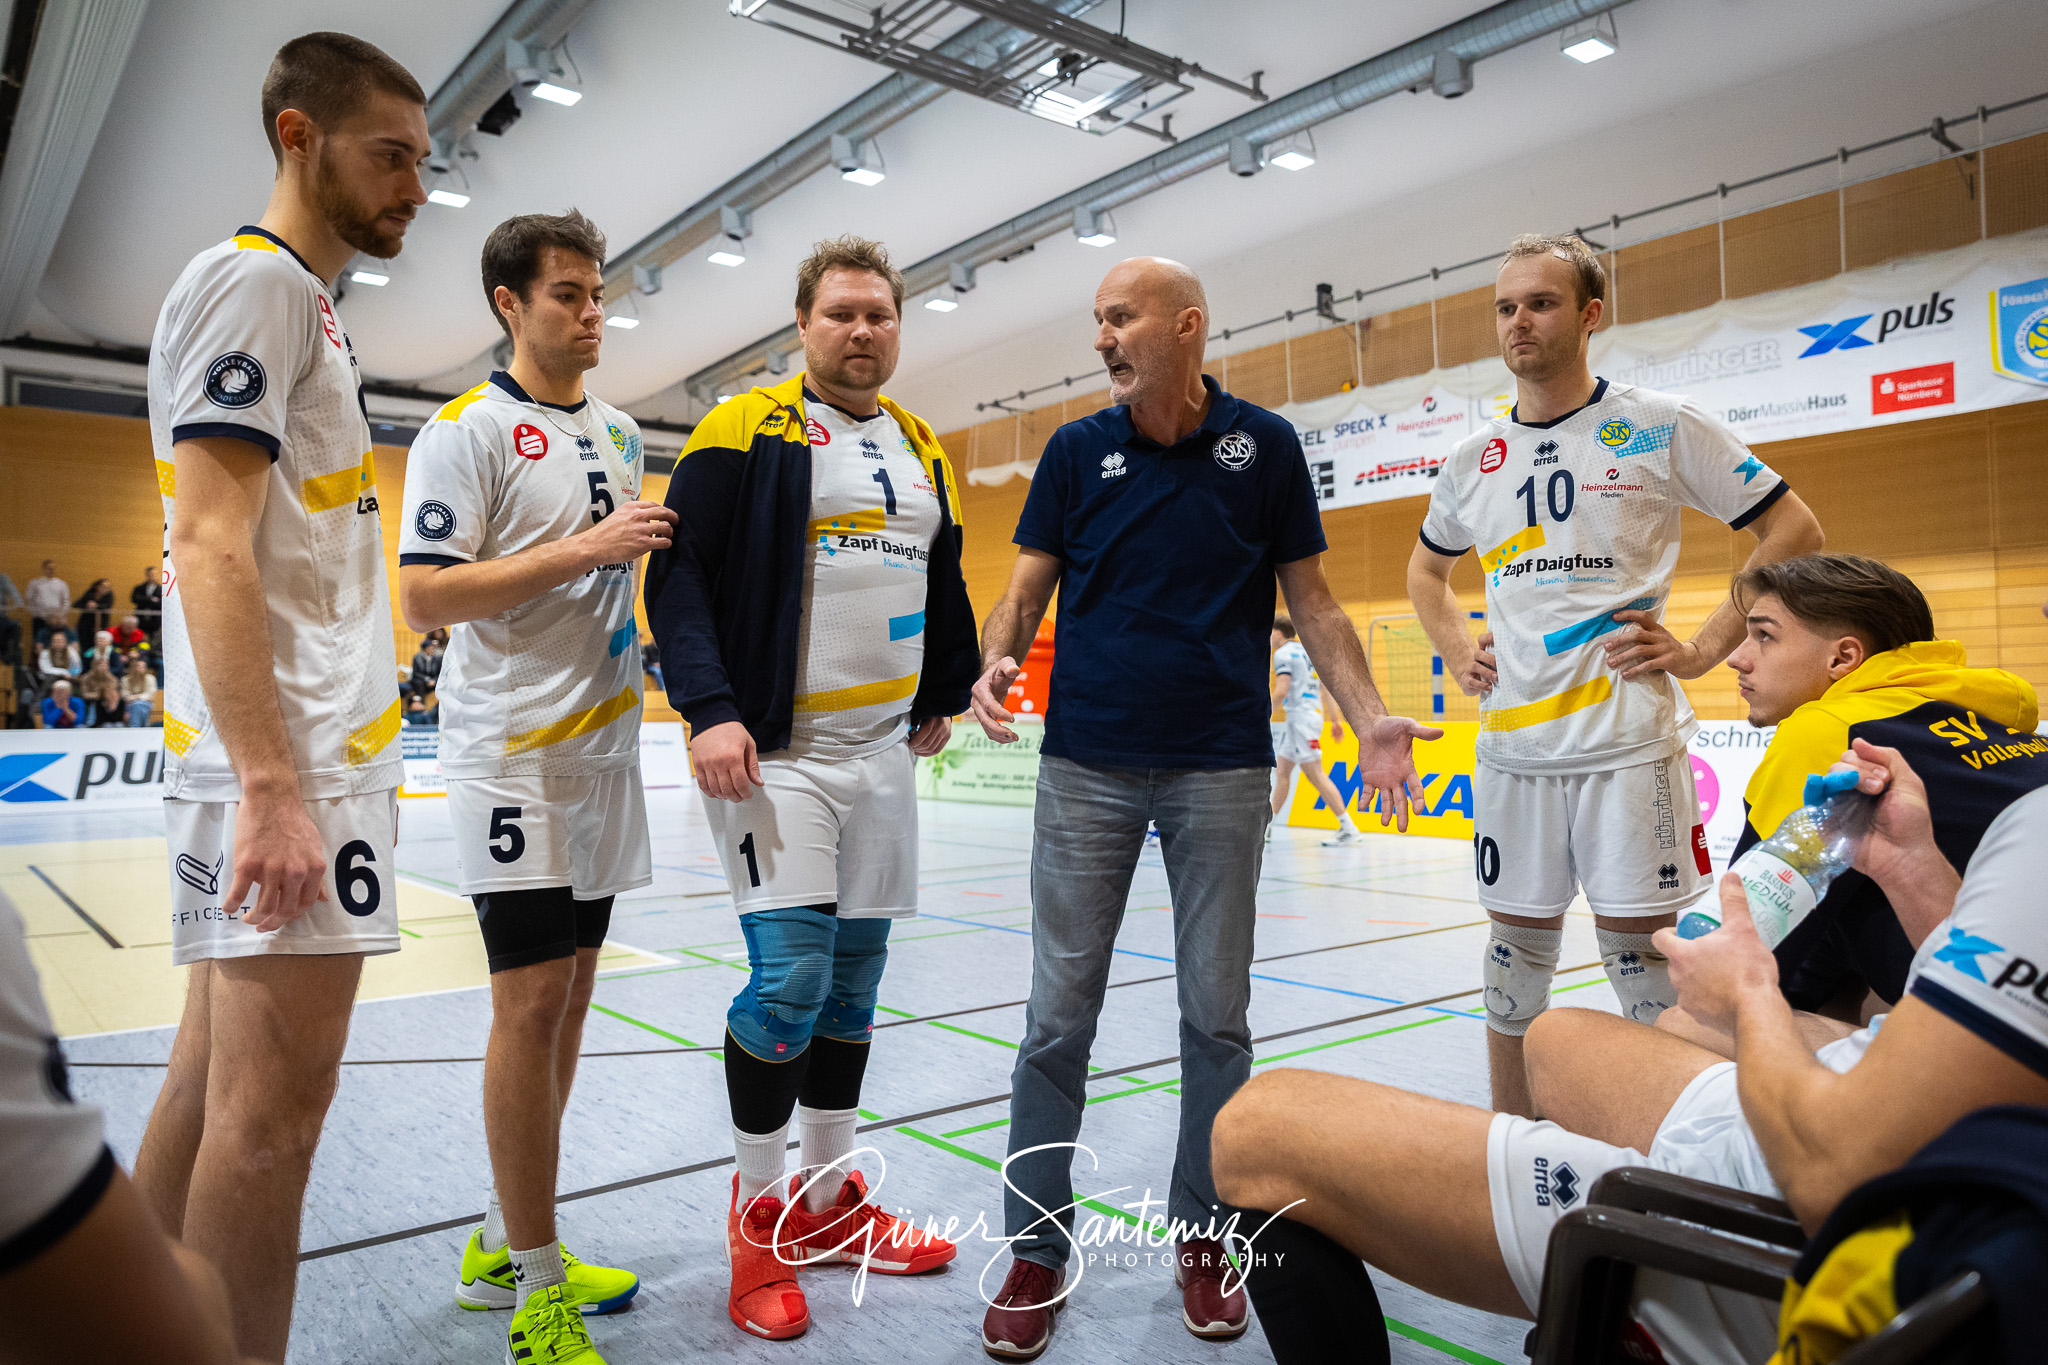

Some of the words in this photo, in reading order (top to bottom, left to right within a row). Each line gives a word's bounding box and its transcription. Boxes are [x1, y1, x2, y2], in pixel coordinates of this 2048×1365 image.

[1877, 291, 1955, 343] puls
[211, 358, 259, 379] VOLLEYBALL
[1896, 375, 1945, 393] Sparkasse
[210, 386, 257, 403] BUNDESLIGA
[1897, 387, 1943, 402] Nürnberg
[1334, 418, 1375, 438] SPECK
[1396, 412, 1465, 434] Heinzelmann
[579, 452, 600, 462] errea
[862, 450, 885, 461] errea
[1533, 454, 1559, 467] errea
[1101, 466, 1127, 479] errea
[586, 470, 616, 525] 5
[871, 467, 898, 516] 1
[1581, 482, 1644, 493] Heinzelmann
[1600, 491, 1625, 500] Medien
[1516, 468, 1576, 528] 10
[419, 504, 451, 521] VOLLEYBALL
[837, 535, 879, 552] Zapf
[1502, 558, 1534, 578] Zapf
[1536, 553, 1614, 574] Daigfuss
[1928, 710, 1988, 747] SV
[75, 751, 164, 800] pu
[488, 806, 526, 864] 5
[738, 831, 762, 888] 1
[1473, 832, 1501, 887] 10
[334, 839, 381, 917] 6
[1658, 879, 1680, 890] errea
[1759, 869, 1796, 900] BASINUS
[1490, 953, 1511, 969] errea
[1620, 965, 1646, 977] errea
[1534, 1156, 1551, 1207] errea
